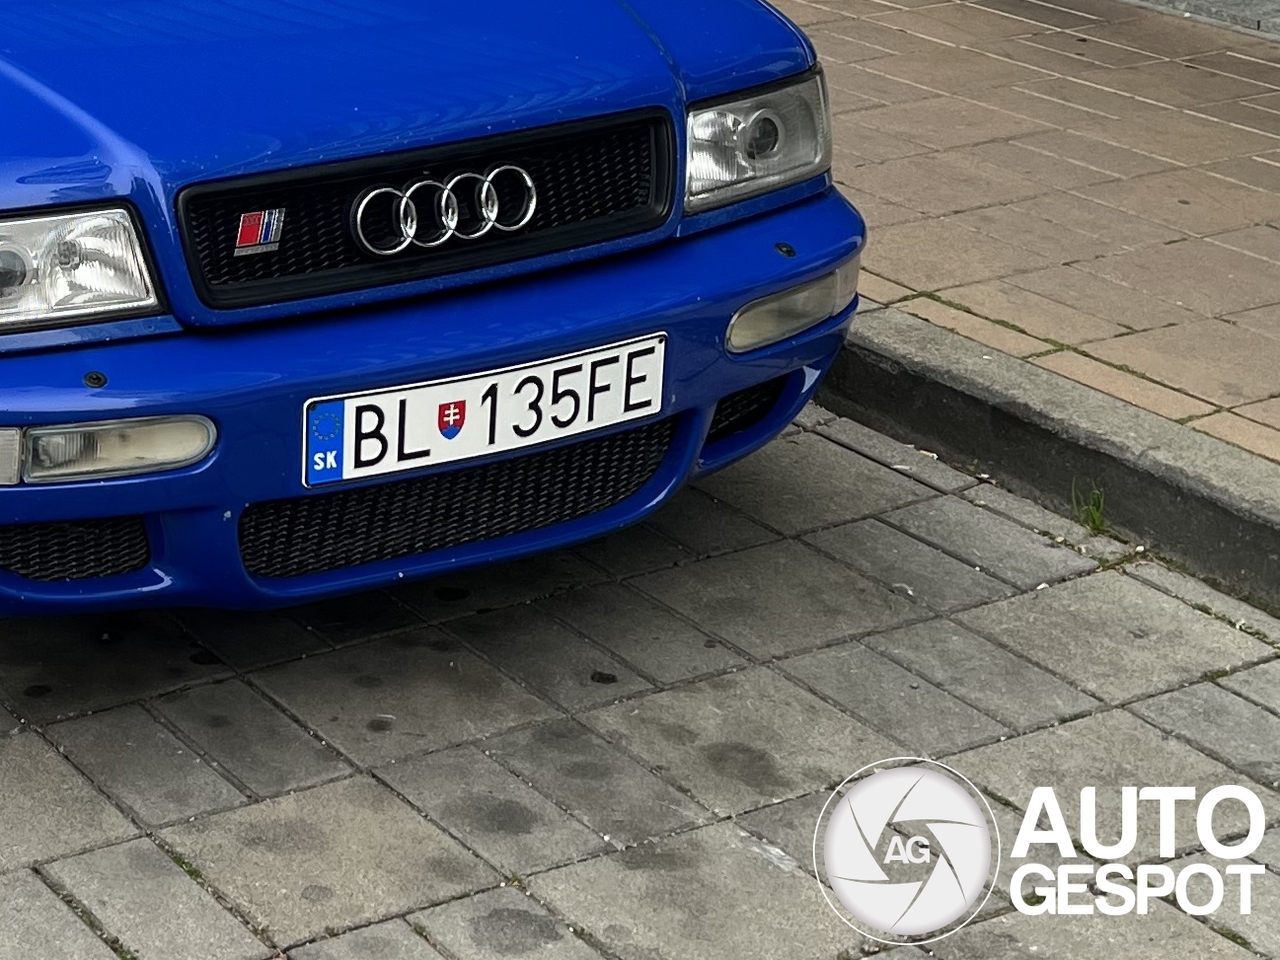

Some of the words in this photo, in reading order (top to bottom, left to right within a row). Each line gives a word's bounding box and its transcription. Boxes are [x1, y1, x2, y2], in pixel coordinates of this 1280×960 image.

[353, 399, 431, 469] BL
[480, 346, 656, 446] 135FE
[313, 451, 338, 472] SK
